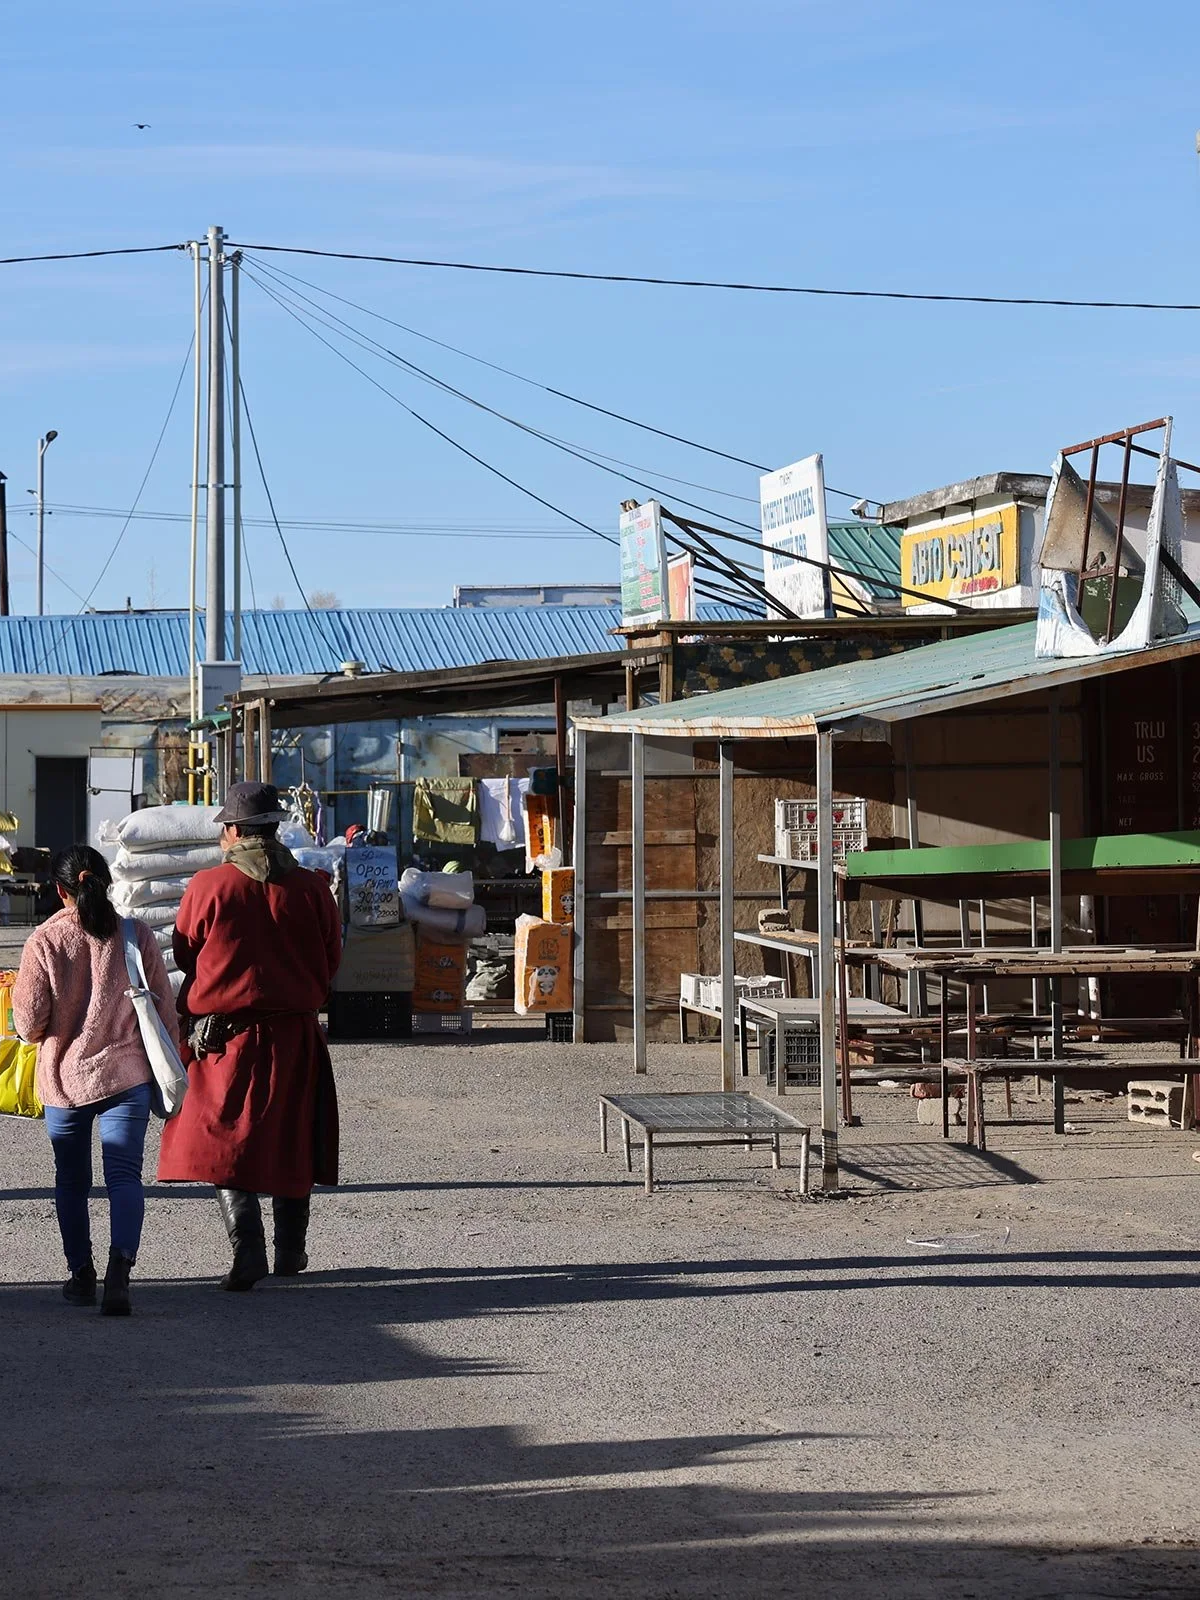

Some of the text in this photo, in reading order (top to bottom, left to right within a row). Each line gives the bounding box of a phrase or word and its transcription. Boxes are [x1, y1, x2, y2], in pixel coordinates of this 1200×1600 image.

[912, 537, 944, 585] АВТО
[1134, 721, 1165, 739] TRLU
[1137, 745, 1155, 763] US
[1117, 772, 1164, 781] MAX GROSS
[356, 864, 389, 877] ОРОС
